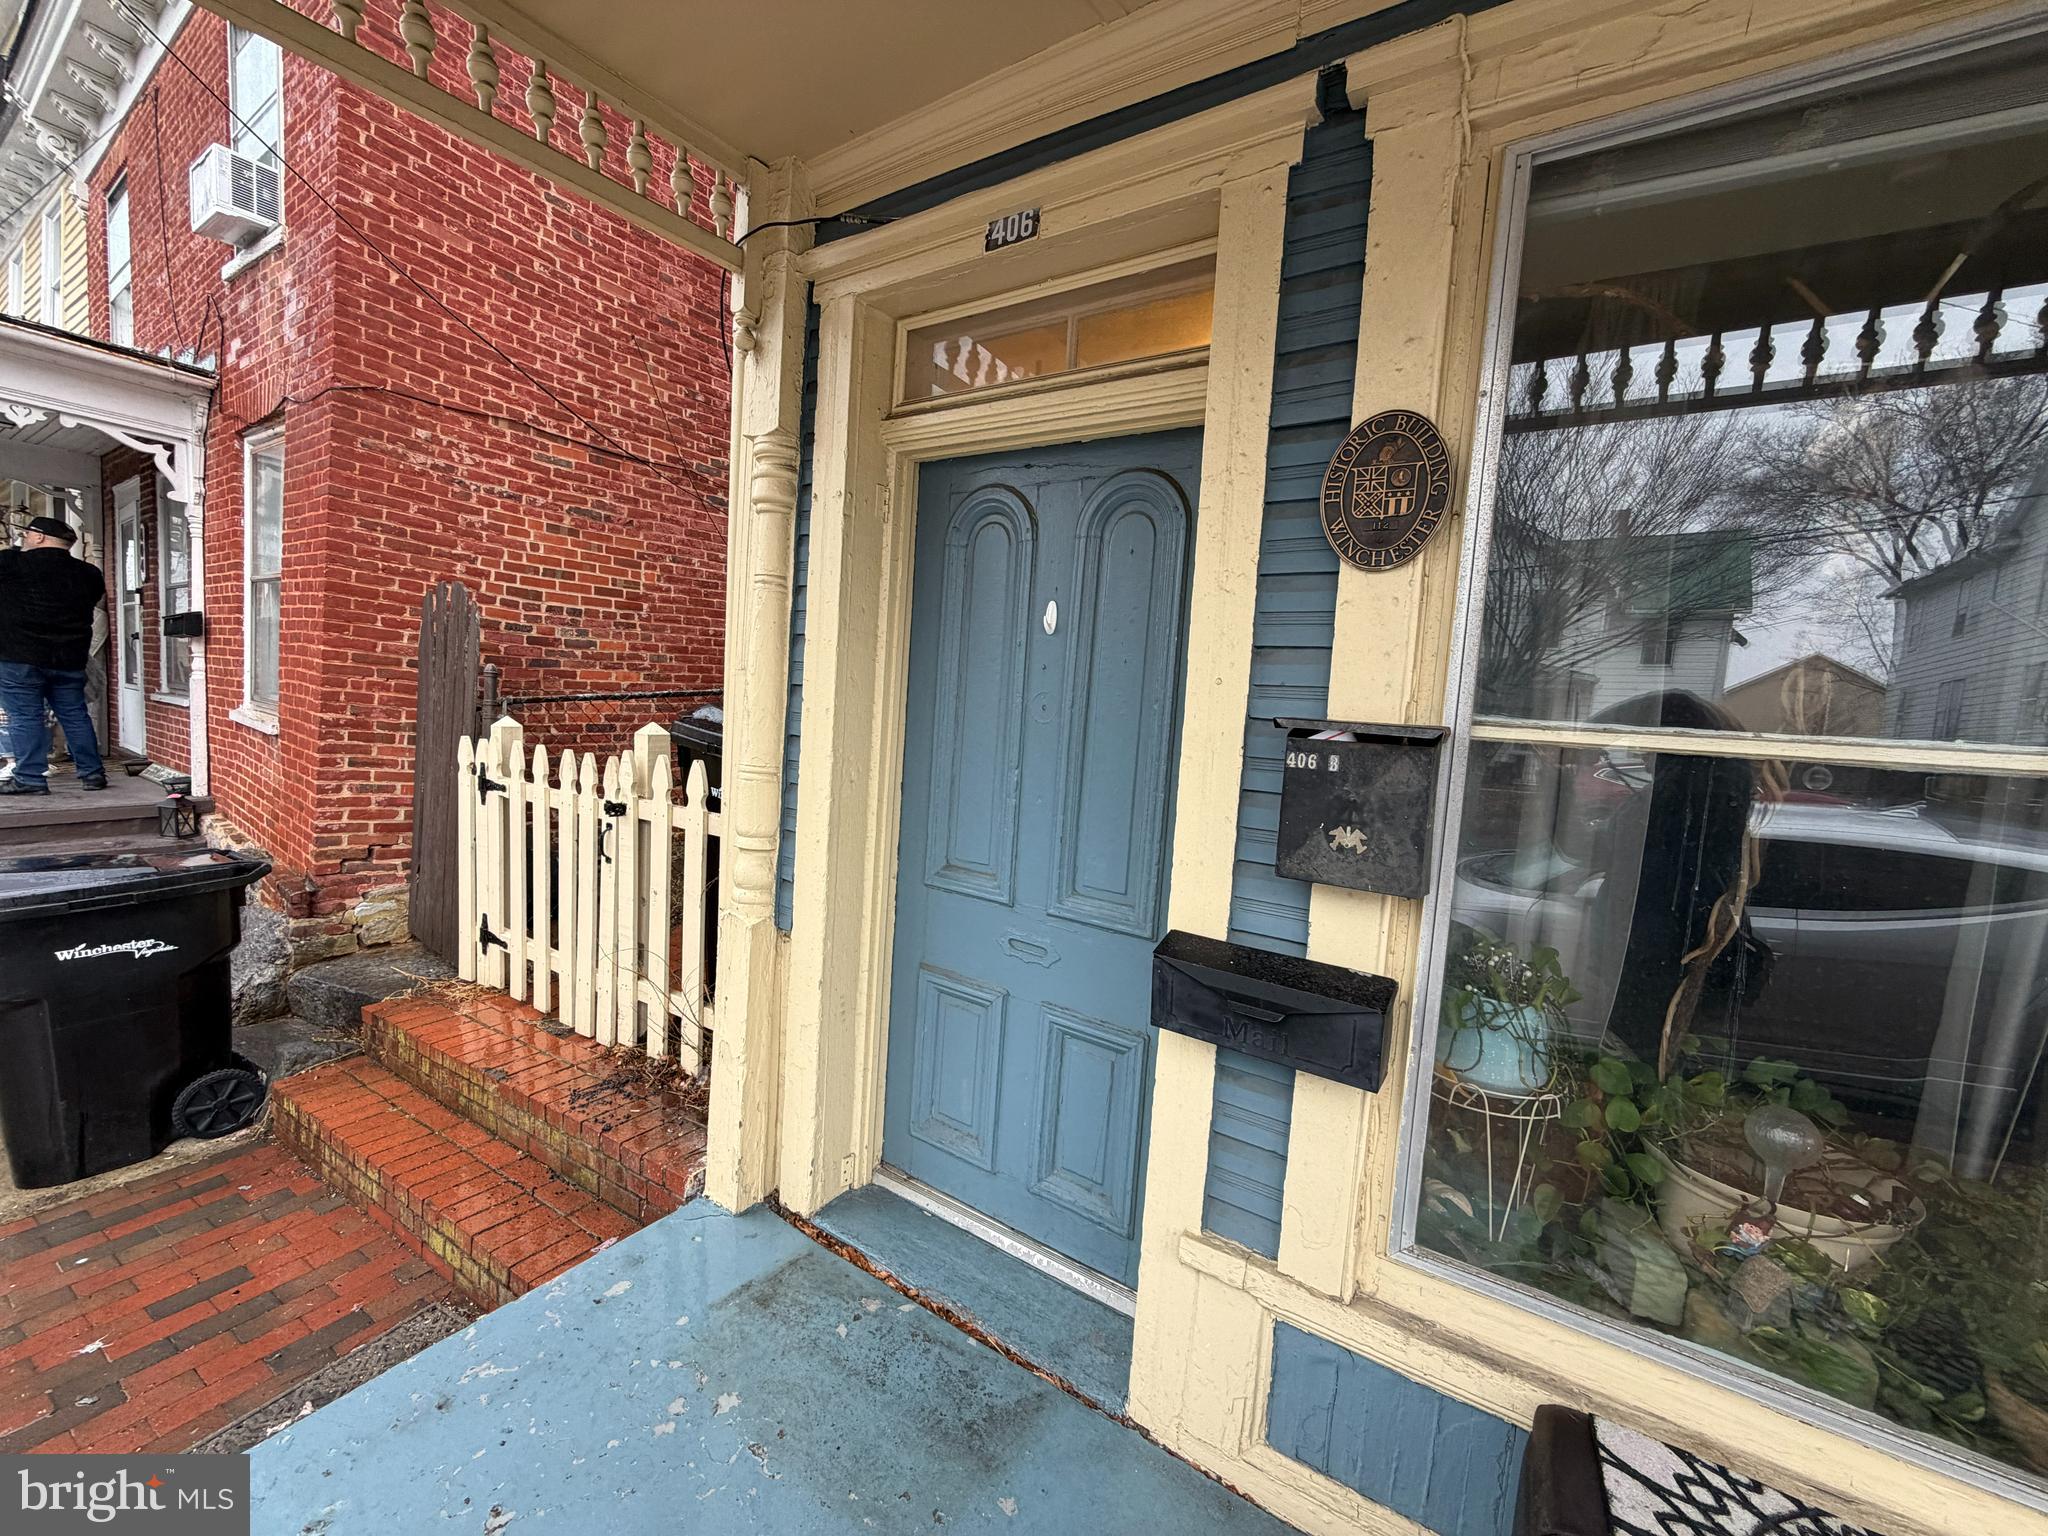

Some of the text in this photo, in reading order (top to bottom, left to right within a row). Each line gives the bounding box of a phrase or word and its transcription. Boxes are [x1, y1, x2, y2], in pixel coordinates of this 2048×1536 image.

[991, 209, 1034, 245] 406
[1325, 415, 1449, 503] HISTORIC BUILDING
[1329, 509, 1443, 566] WINCHESTER
[1286, 752, 1317, 769] 406
[54, 938, 156, 961] Winchester
[1223, 1015, 1289, 1056] Mail
